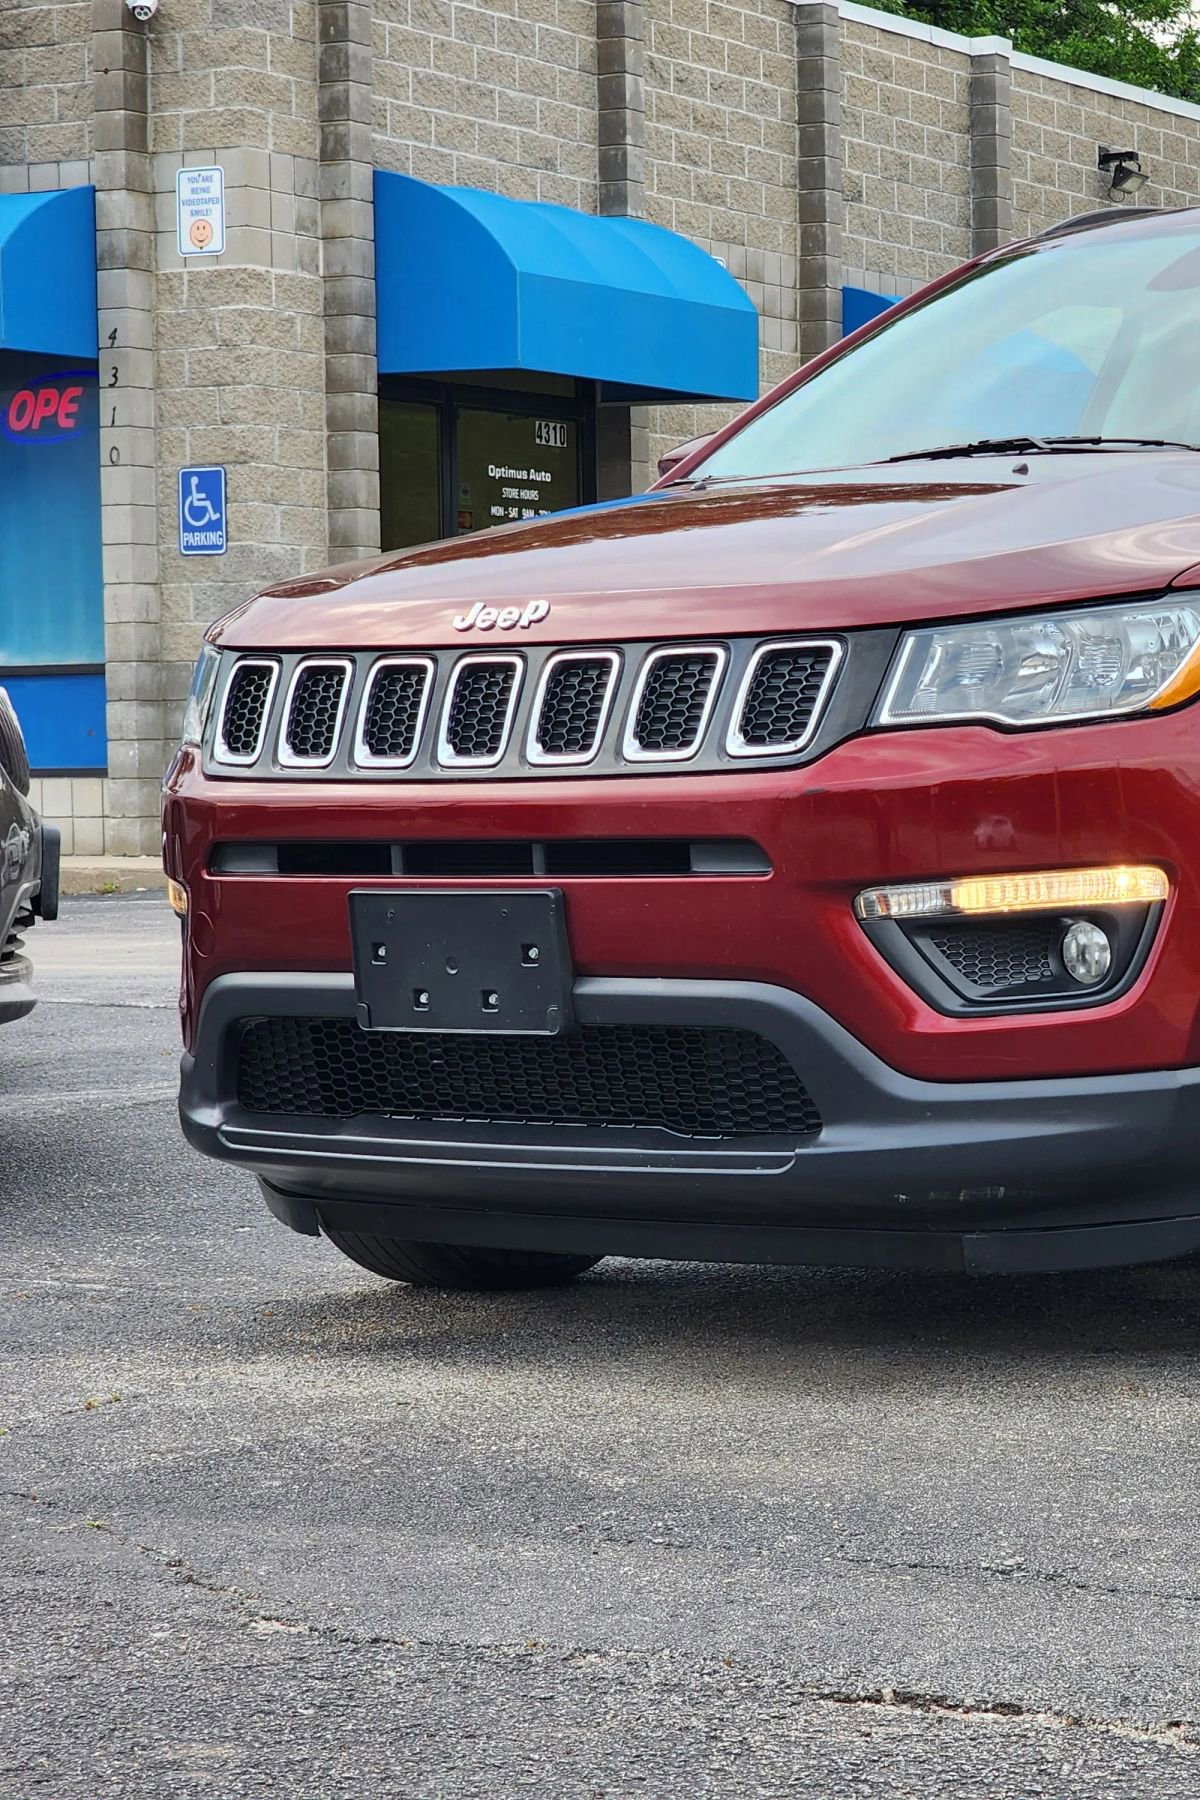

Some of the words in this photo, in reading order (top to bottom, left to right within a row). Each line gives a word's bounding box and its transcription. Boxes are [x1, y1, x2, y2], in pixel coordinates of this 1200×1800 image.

[187, 175, 200, 184] YOU
[201, 174, 214, 183] ARE
[190, 186, 210, 195] BEING
[181, 197, 220, 206] VIDEOTAPED
[9, 386, 84, 432] OPE
[536, 422, 566, 446] 4310
[488, 464, 528, 480] Optimus
[529, 468, 552, 482] Auto
[502, 487, 519, 499] STORE
[520, 489, 539, 501] HOURS
[183, 531, 223, 547] PARKING
